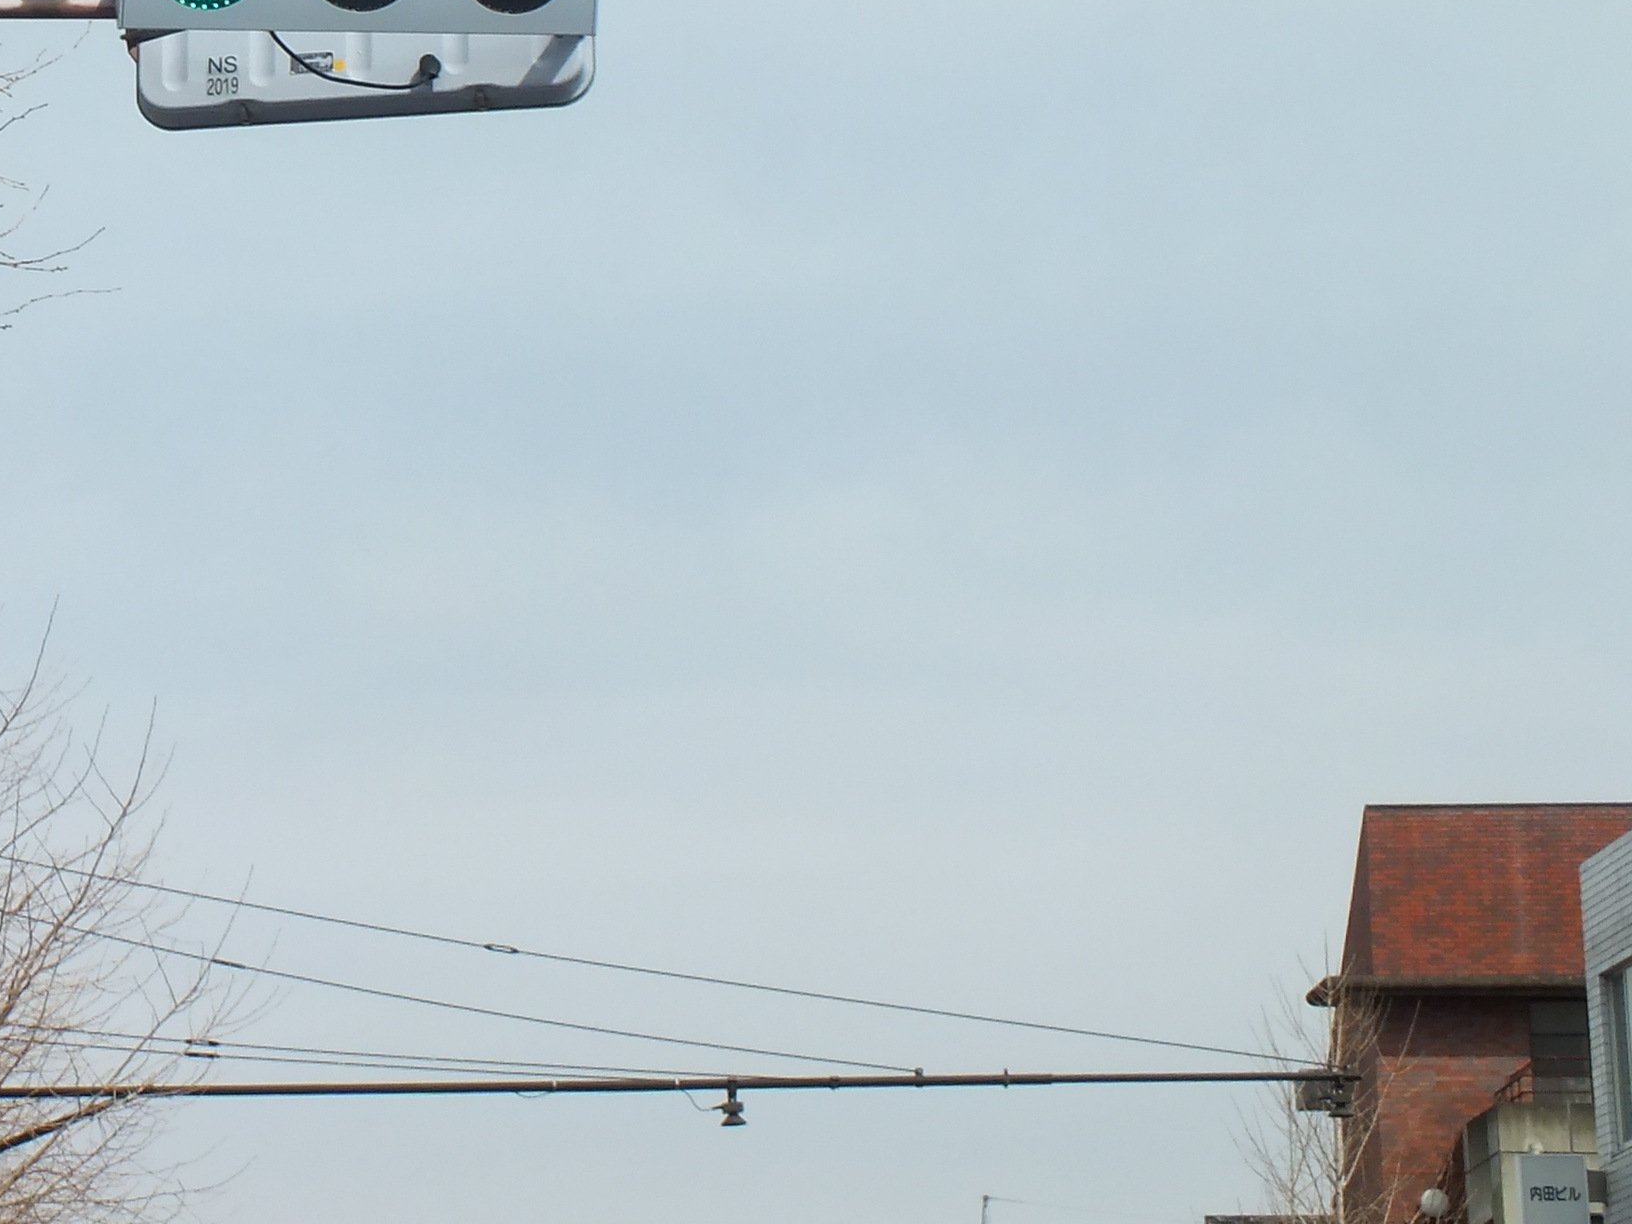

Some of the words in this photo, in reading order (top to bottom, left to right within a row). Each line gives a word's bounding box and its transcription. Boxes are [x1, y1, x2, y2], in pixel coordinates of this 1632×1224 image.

[208, 56, 238, 74] NS
[206, 76, 239, 96] 2019
[1529, 1185, 1582, 1202] 内田ビル
